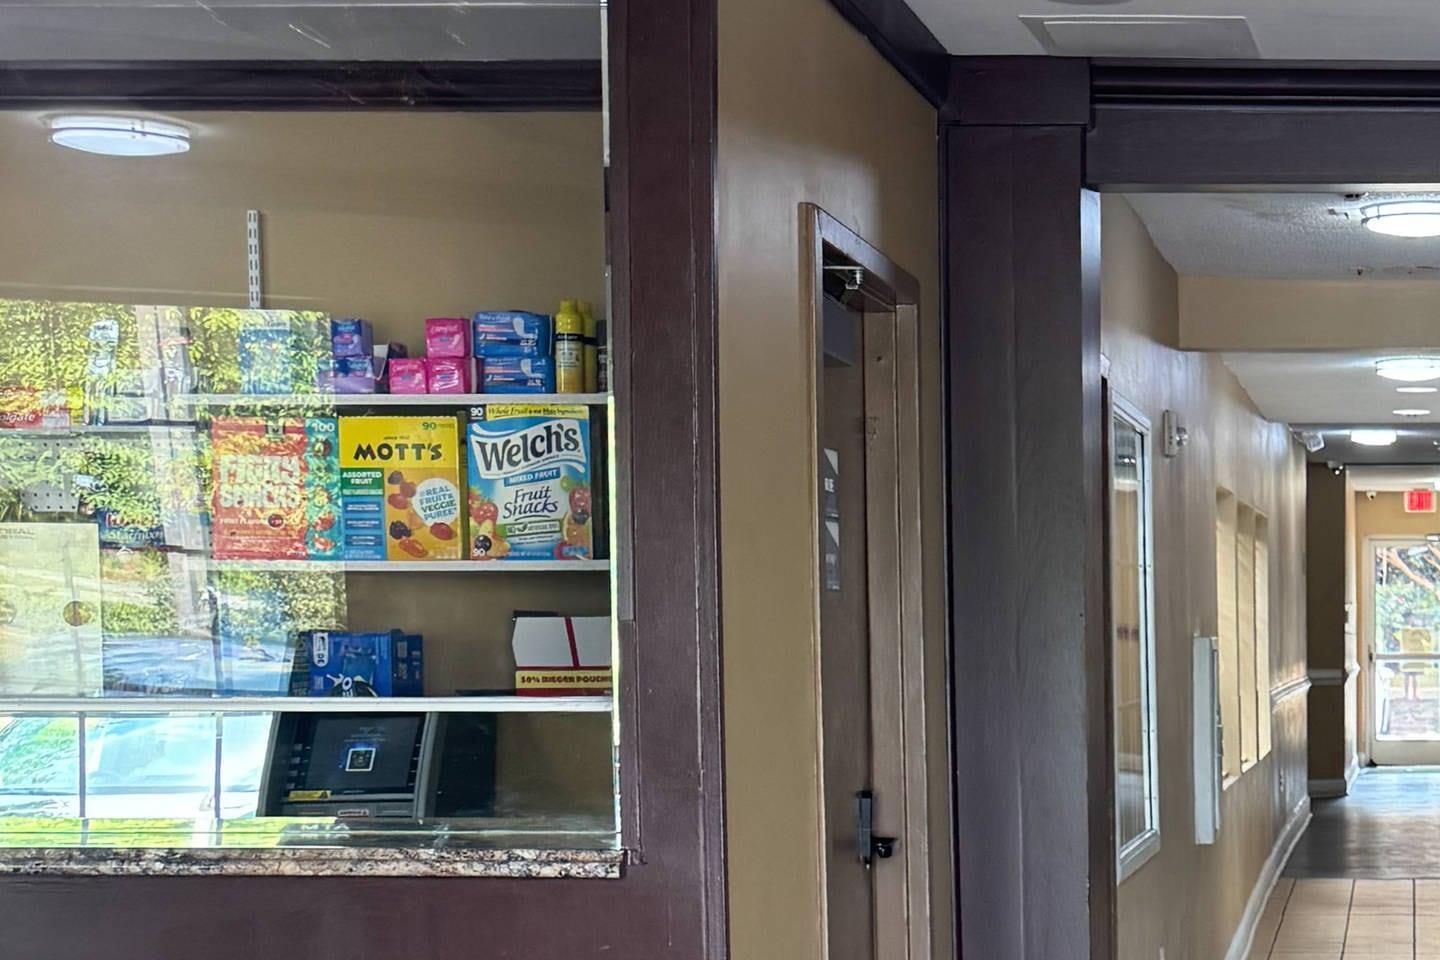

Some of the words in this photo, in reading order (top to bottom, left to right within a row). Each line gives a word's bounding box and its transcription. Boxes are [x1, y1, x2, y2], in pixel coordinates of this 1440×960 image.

[0, 411, 36, 424] olgate
[470, 407, 484, 416] 90
[312, 423, 335, 432] 100
[422, 422, 437, 430] 90
[353, 443, 443, 461] MOTT'S
[475, 423, 580, 472] Welch's
[514, 486, 552, 504] Fruit
[421, 500, 457, 512] VEGGIE
[503, 500, 559, 519] Snacks
[472, 548, 486, 557] 90
